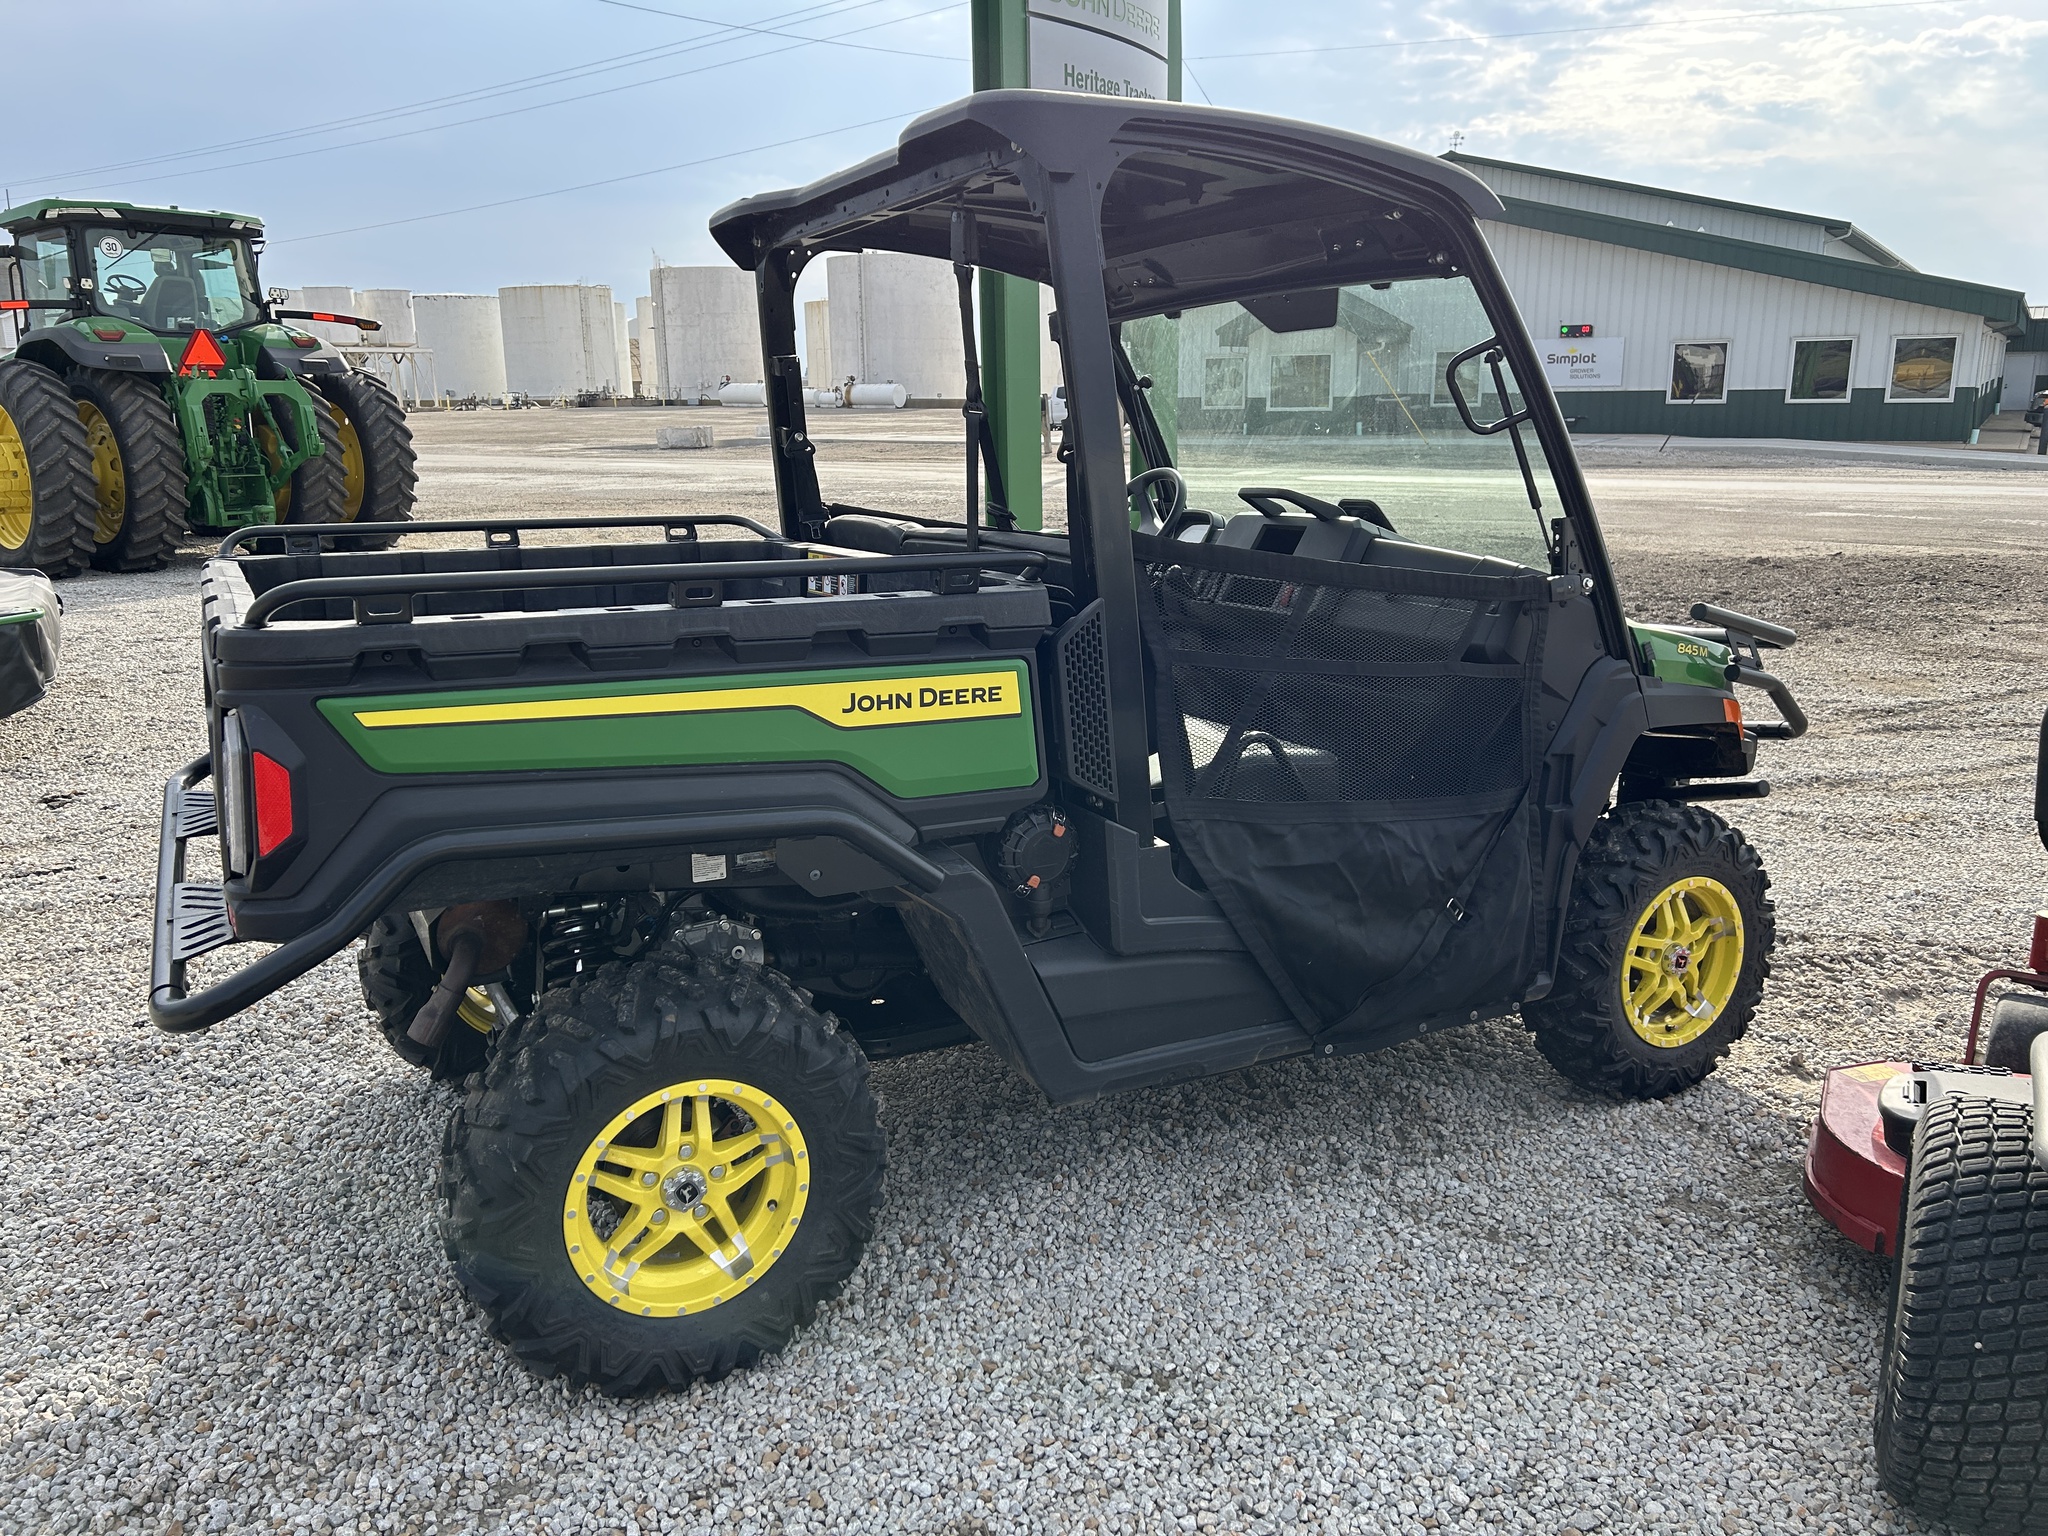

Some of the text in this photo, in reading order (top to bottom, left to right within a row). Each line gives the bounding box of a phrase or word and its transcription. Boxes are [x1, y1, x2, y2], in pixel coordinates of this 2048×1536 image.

[1064, 63, 1120, 96] Heritage
[105, 242, 117, 251] 30
[1546, 353, 1596, 367] Simplot
[842, 686, 1002, 714] JOHN DEERE
